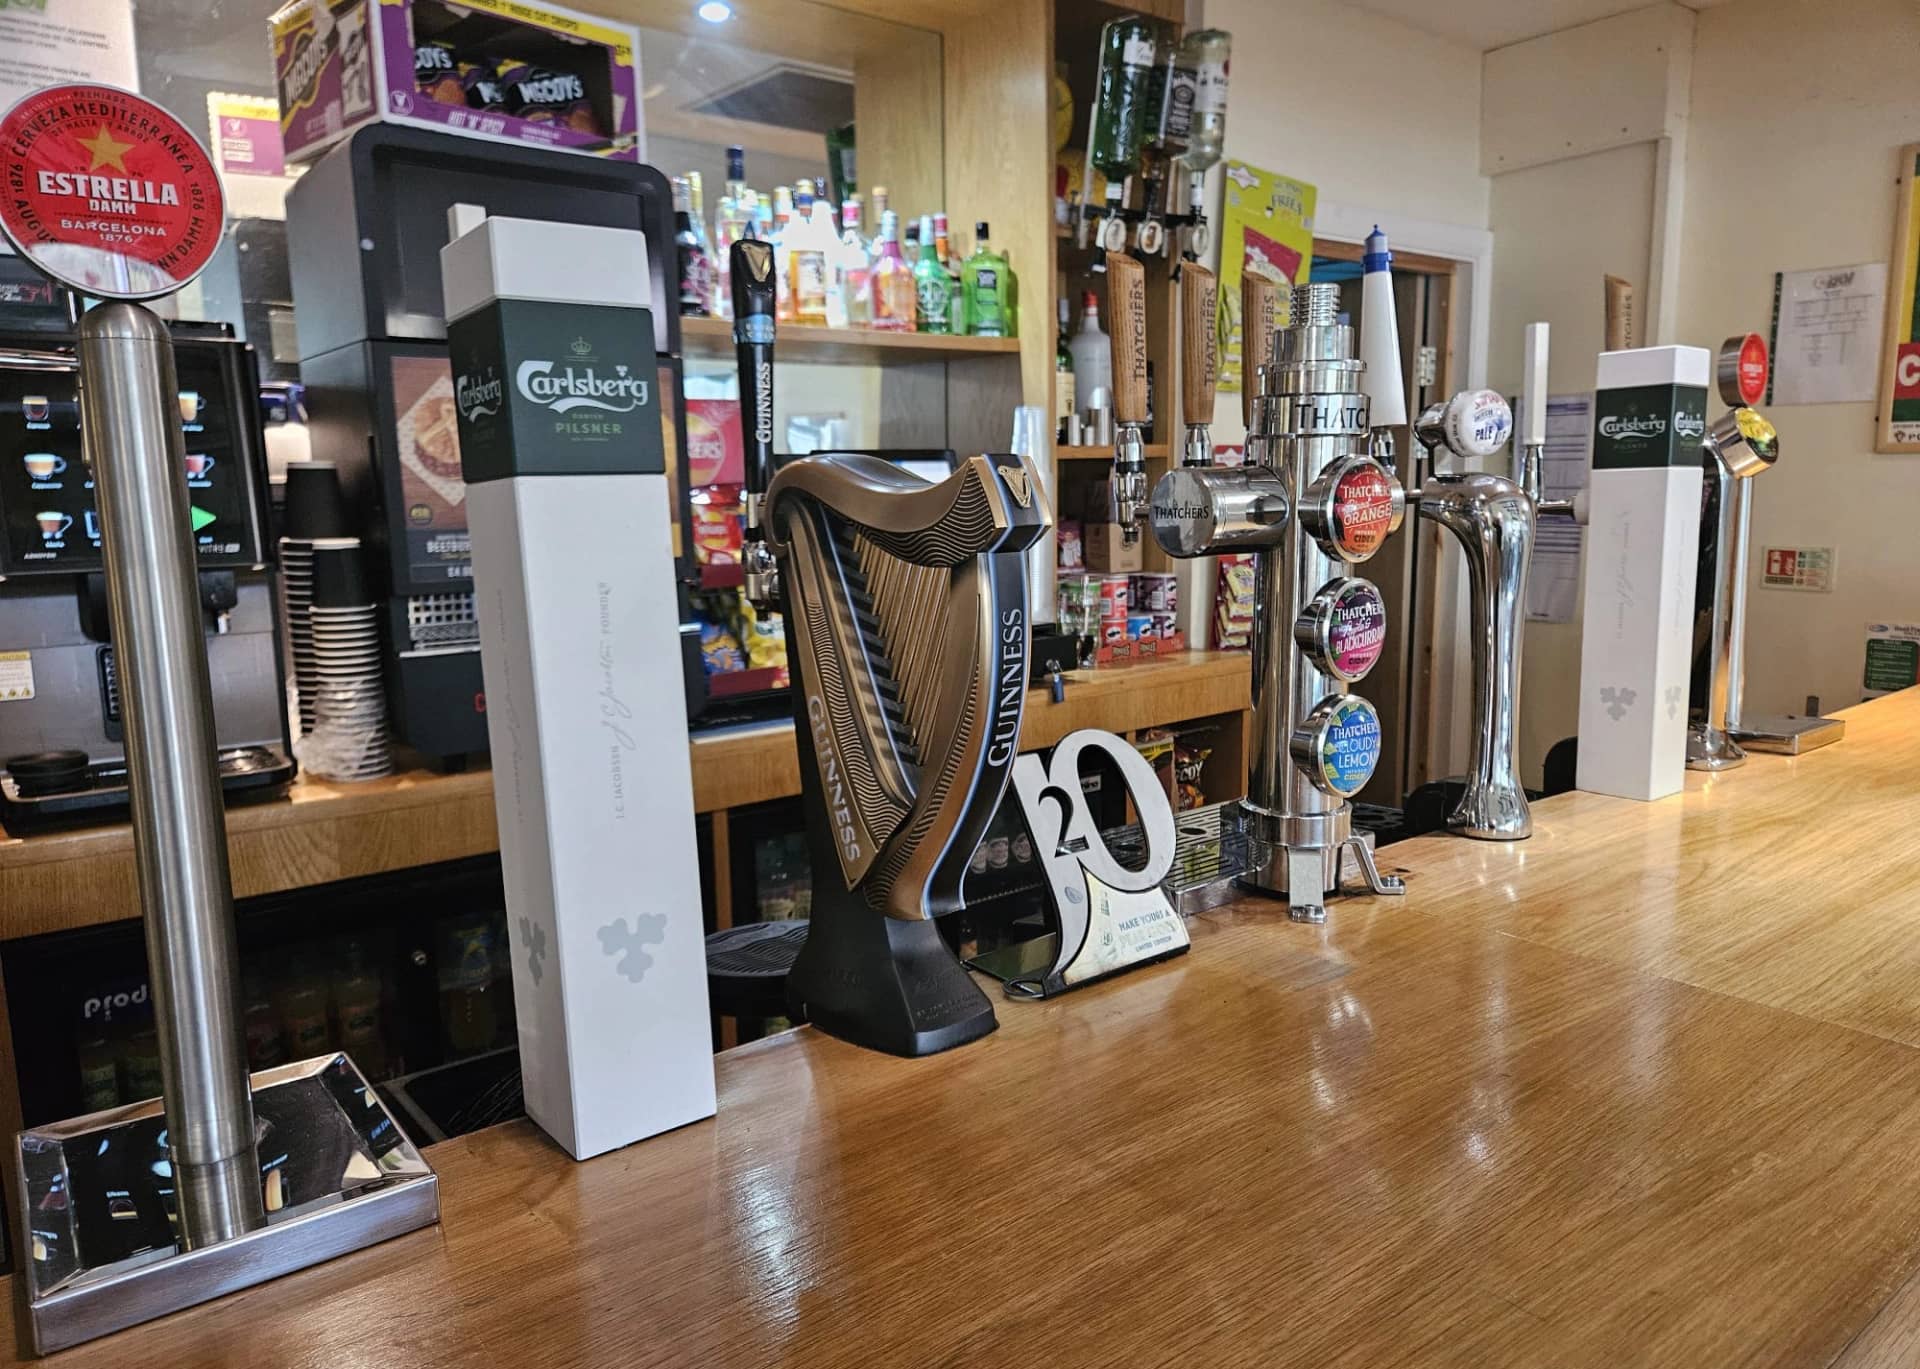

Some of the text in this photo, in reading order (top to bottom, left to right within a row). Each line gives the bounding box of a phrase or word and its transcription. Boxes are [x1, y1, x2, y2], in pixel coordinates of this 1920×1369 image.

[14, 104, 72, 159] CERVEZA
[37, 170, 181, 206] ESTRELLA
[88, 199, 137, 215] DAMM
[61, 218, 168, 237] BARCELONA
[99, 233, 134, 244] 1876
[177, 217, 205, 257] DAMM
[1133, 279, 1145, 382] THATCHERS
[1205, 287, 1216, 386] THATCHERS
[457, 368, 503, 423] Carlsberg
[516, 360, 649, 414] Carlsberg
[755, 361, 772, 444] GUINNESS
[555, 422, 623, 434] PILSNER
[1598, 413, 1667, 440] Carlsberg
[1154, 504, 1210, 521] THATCHERS
[1343, 502, 1392, 526] ORANGE
[987, 607, 1023, 768] GUINNESS
[1338, 737, 1377, 754] CLOUDY
[1339, 752, 1377, 768] LEMON
[810, 694, 861, 863] GUINNESS
[1118, 917, 1140, 932] MAKE
[1140, 909, 1164, 925] YOURS
